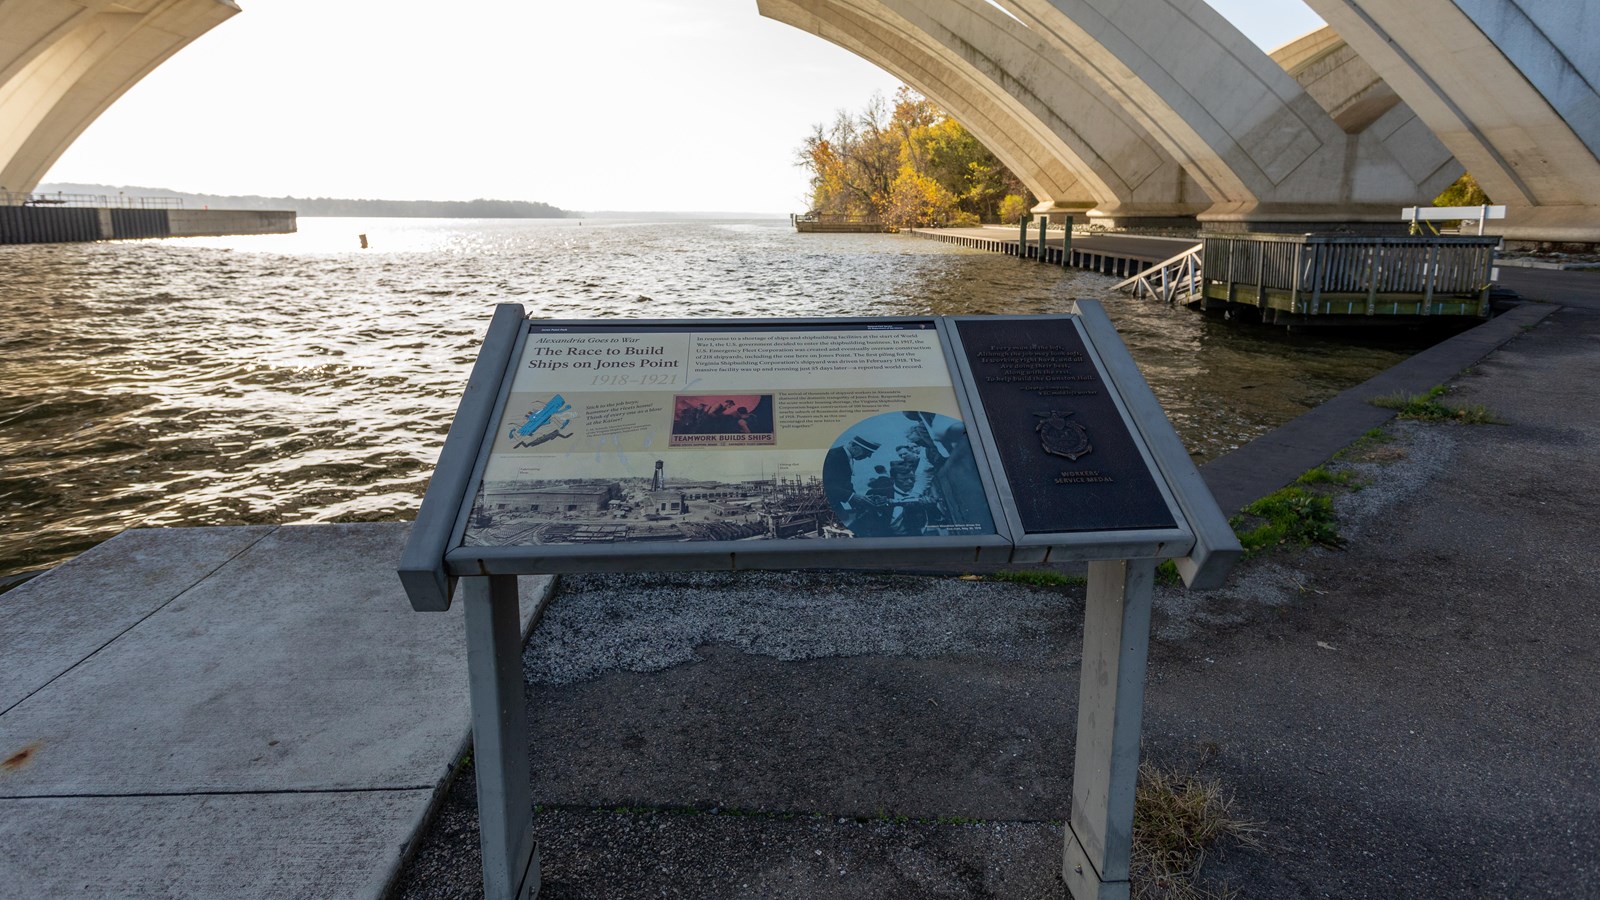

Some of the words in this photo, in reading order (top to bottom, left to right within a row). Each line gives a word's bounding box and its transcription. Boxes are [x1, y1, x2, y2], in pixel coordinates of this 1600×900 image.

[534, 347, 562, 355] The
[567, 347, 602, 355] Race
[625, 346, 664, 355] Build
[528, 360, 568, 370] Ships
[594, 360, 636, 370] Jones
[640, 359, 679, 367] Point
[590, 374, 677, 385] 1918–1921
